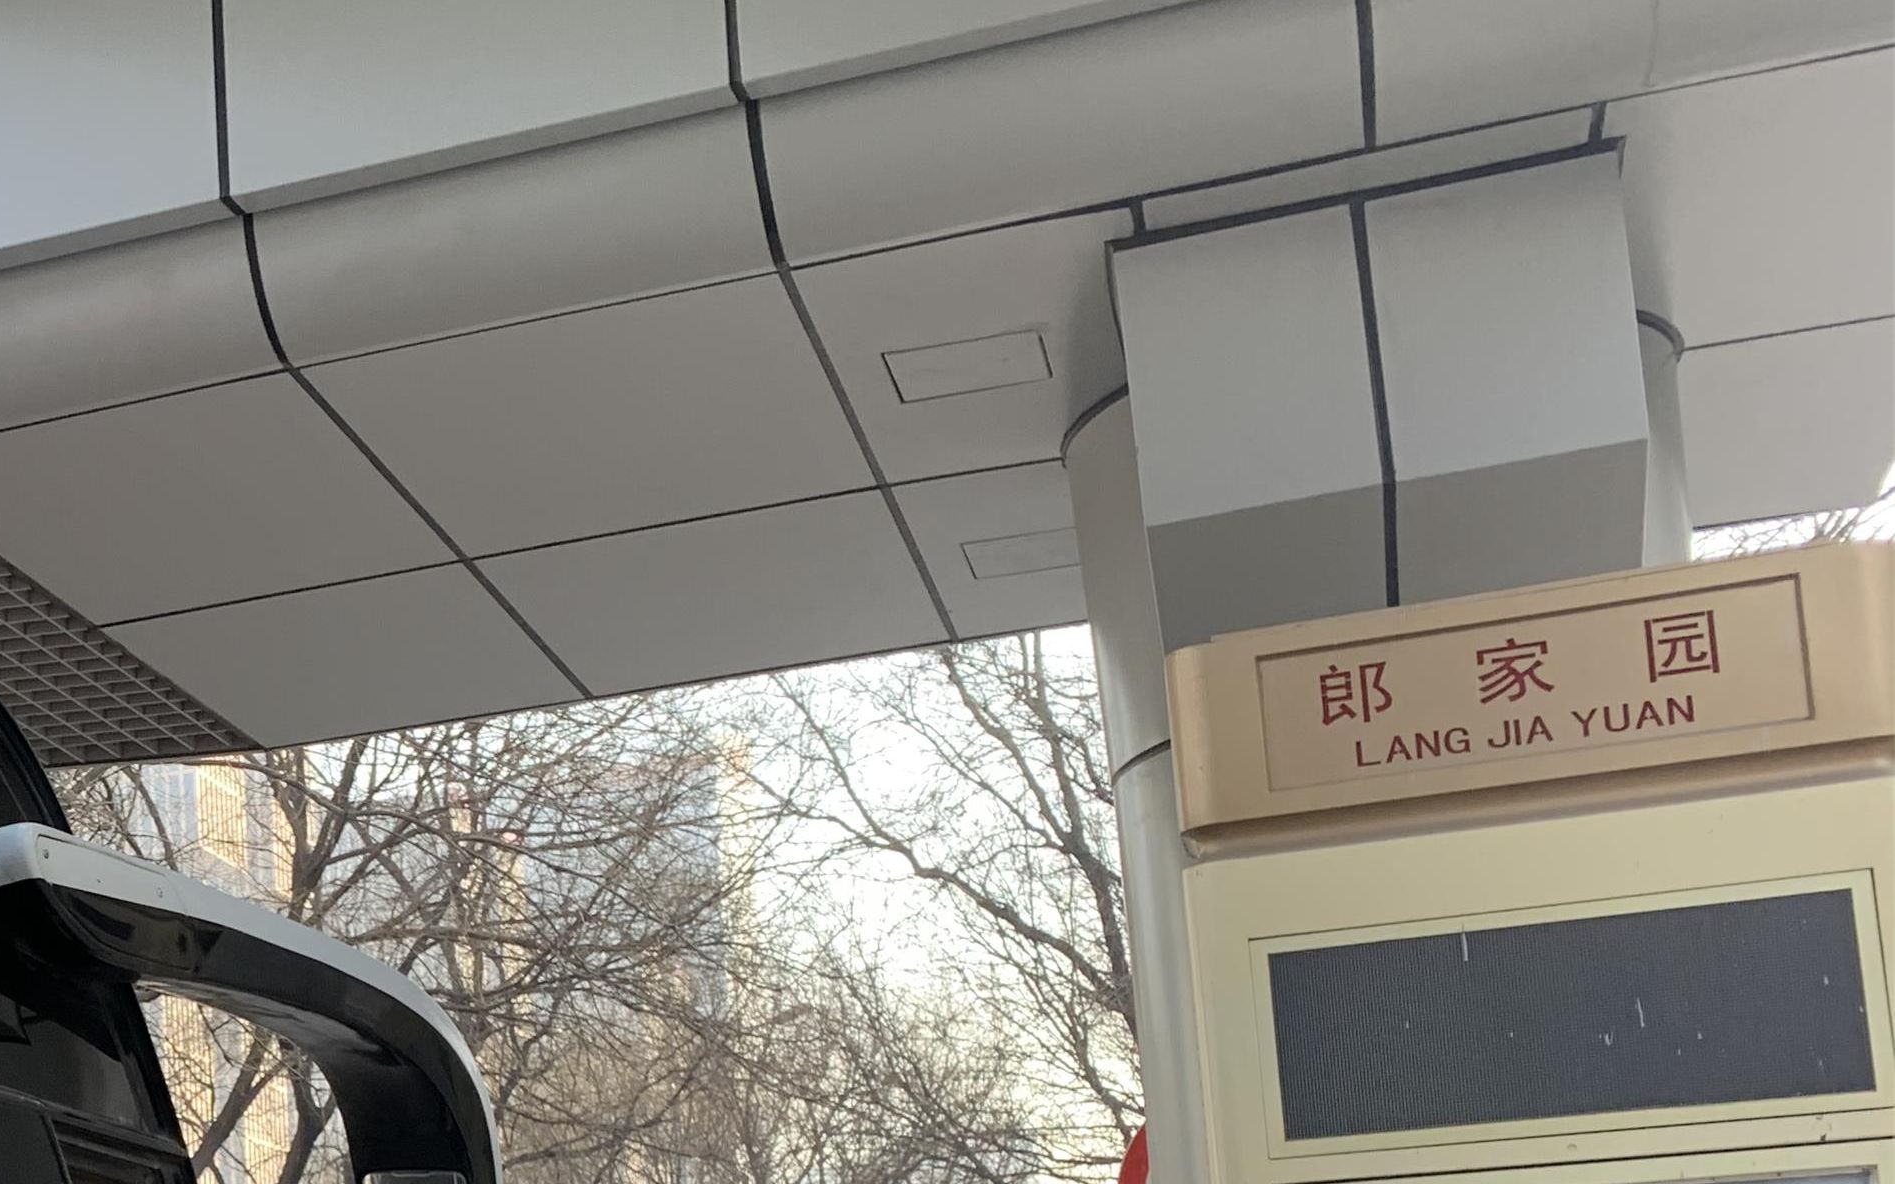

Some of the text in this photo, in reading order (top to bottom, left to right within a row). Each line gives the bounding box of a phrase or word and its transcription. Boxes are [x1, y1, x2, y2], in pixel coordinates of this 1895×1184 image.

[1320, 610, 1720, 725] 郎家园
[1355, 695, 1696, 767] LANG JIA YUAN
